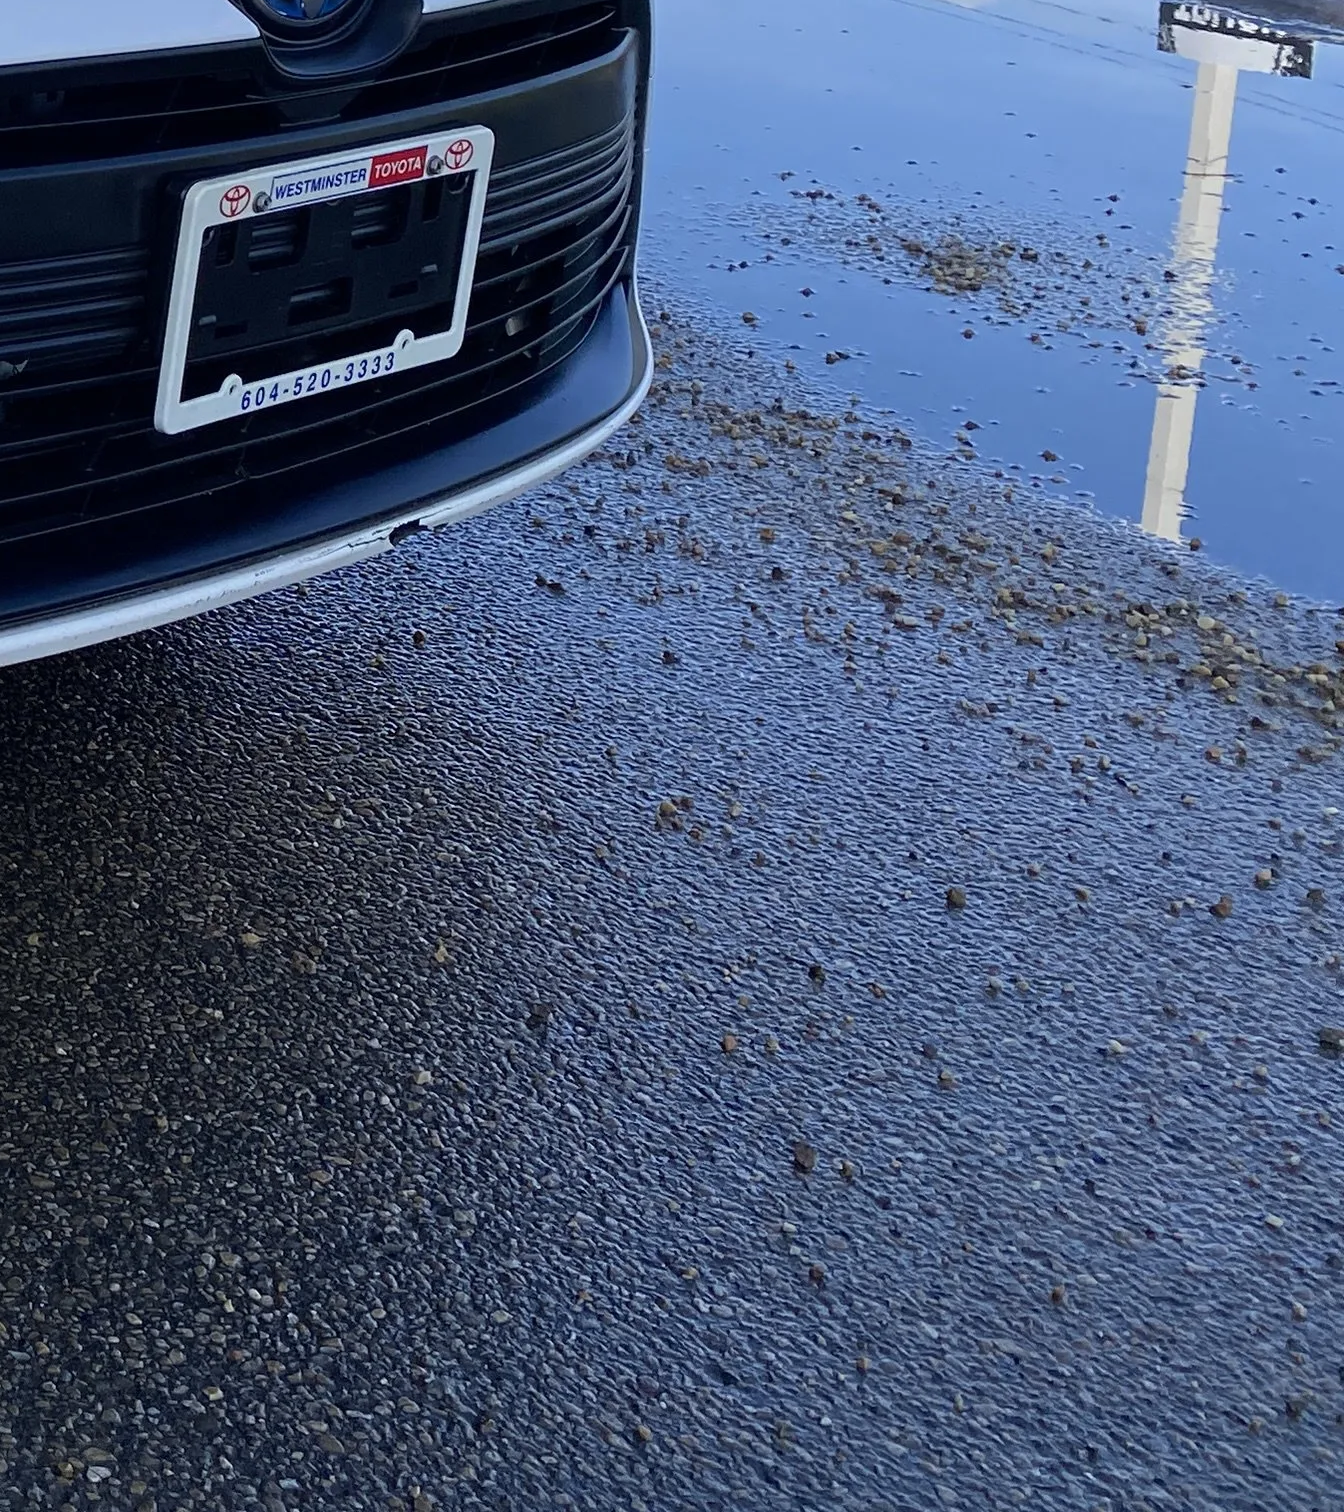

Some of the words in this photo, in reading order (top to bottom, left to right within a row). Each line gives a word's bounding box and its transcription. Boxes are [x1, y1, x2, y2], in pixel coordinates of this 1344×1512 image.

[274, 168, 367, 200] WESTMINSTER
[374, 156, 423, 179] TOYOTA
[240, 351, 395, 411] 604-520-3333
